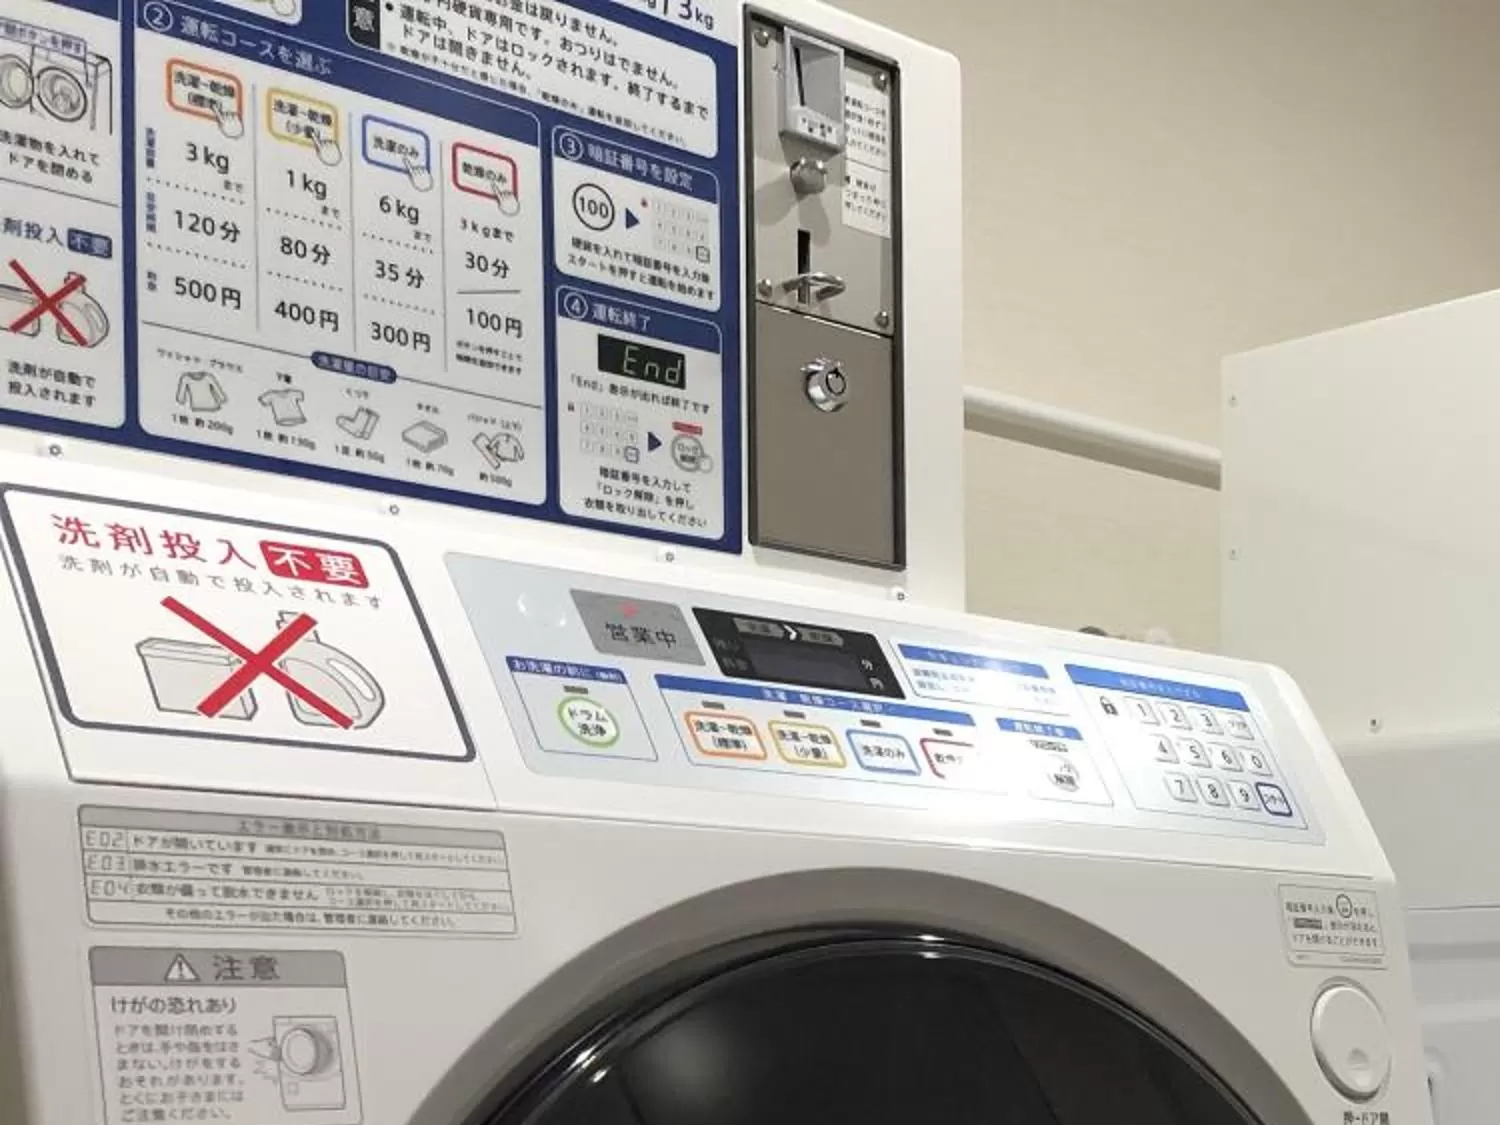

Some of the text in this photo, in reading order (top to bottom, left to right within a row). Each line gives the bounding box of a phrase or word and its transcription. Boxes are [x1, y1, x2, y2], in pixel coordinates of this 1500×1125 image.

[578, 196, 610, 220] 100
[175, 209, 241, 243] 120分
[280, 236, 331, 266] 80分
[465, 251, 510, 280] 30分
[374, 259, 425, 290] 35分
[175, 276, 242, 312] 500円
[274, 300, 340, 333] 400円
[467, 308, 523, 338] 100円
[370, 321, 431, 354] 300円
[622, 345, 683, 386] End
[51, 513, 364, 585] 洗剤投入 不要
[59, 554, 383, 610] 洗剤が自動で投入されます
[1169, 708, 1182, 723] 2
[1188, 745, 1202, 760] 5
[1174, 779, 1186, 794] 7
[214, 954, 280, 981] 注意
